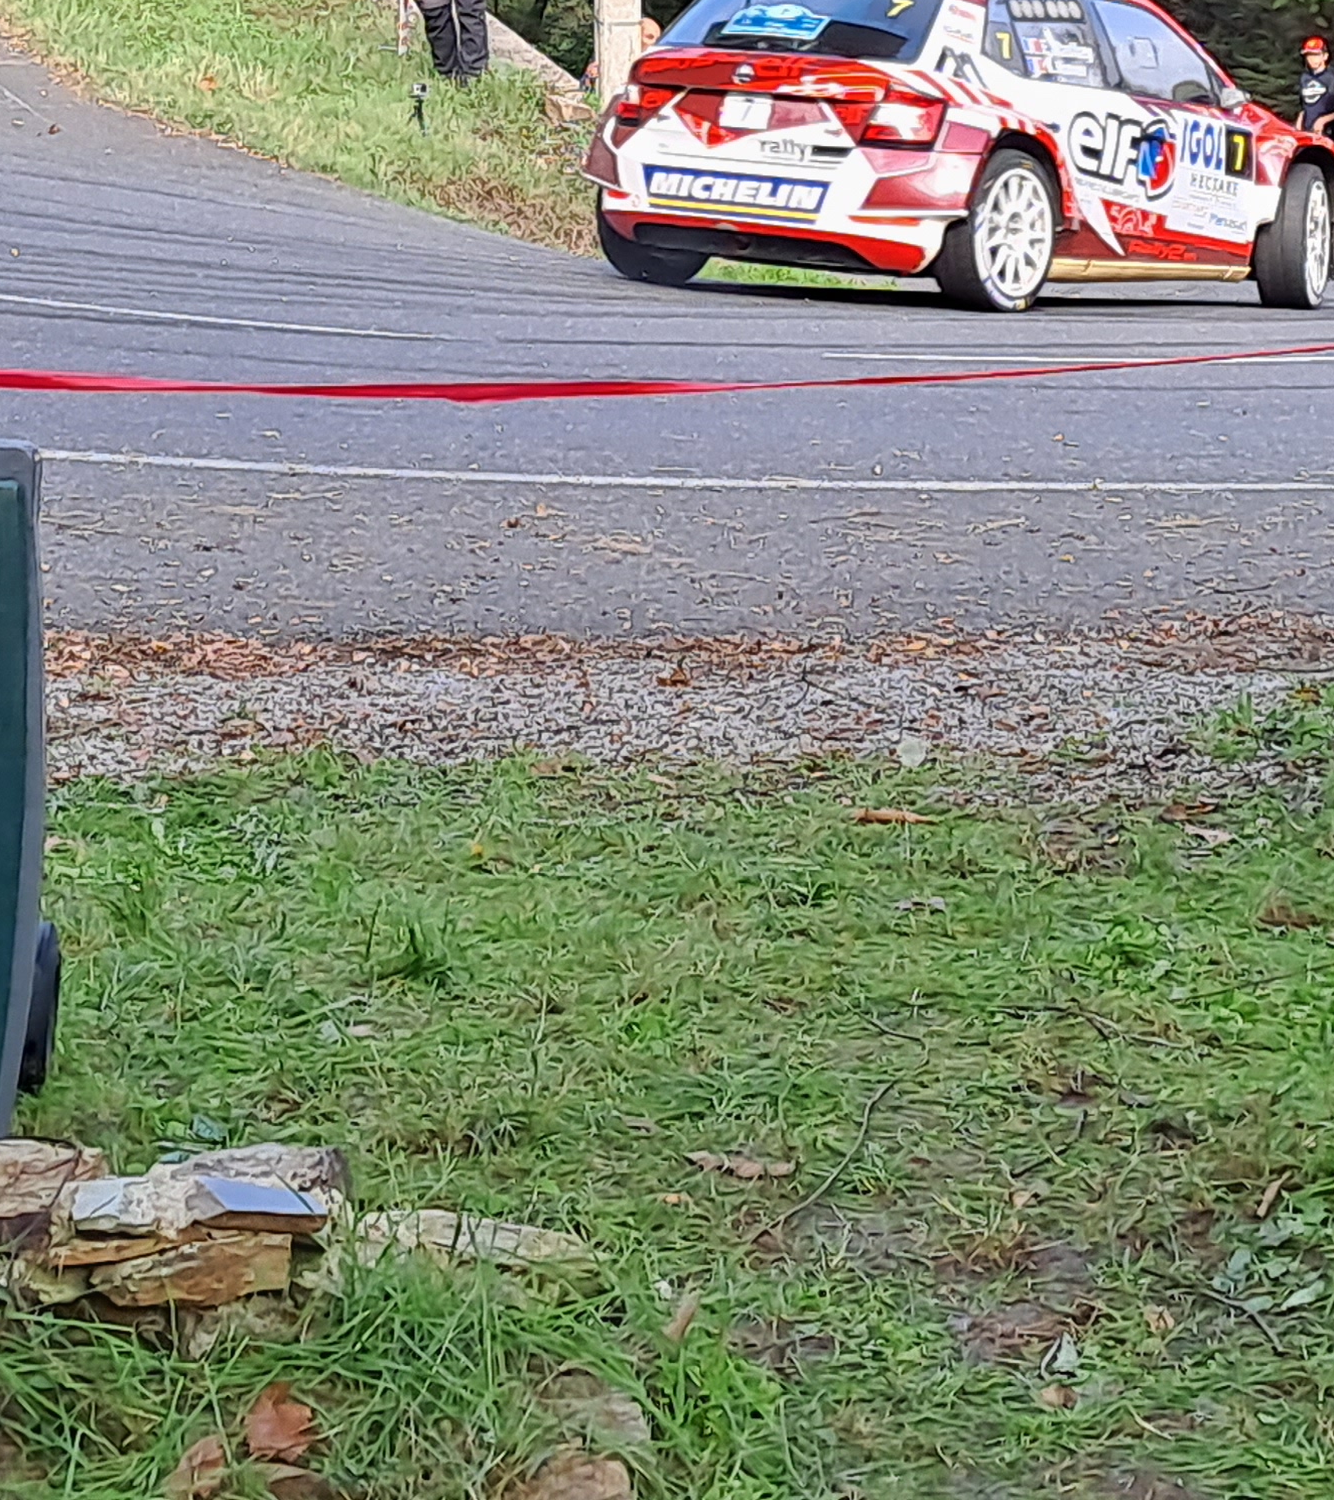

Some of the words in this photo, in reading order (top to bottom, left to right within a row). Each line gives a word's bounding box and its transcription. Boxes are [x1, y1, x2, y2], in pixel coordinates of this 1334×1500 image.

[996, 32, 1012, 59] 7
[759, 138, 809, 162] rally
[1068, 111, 1145, 186] elf
[1180, 119, 1223, 170] IGOL
[1233, 134, 1245, 171] 7
[649, 172, 823, 210] MICHELIN
